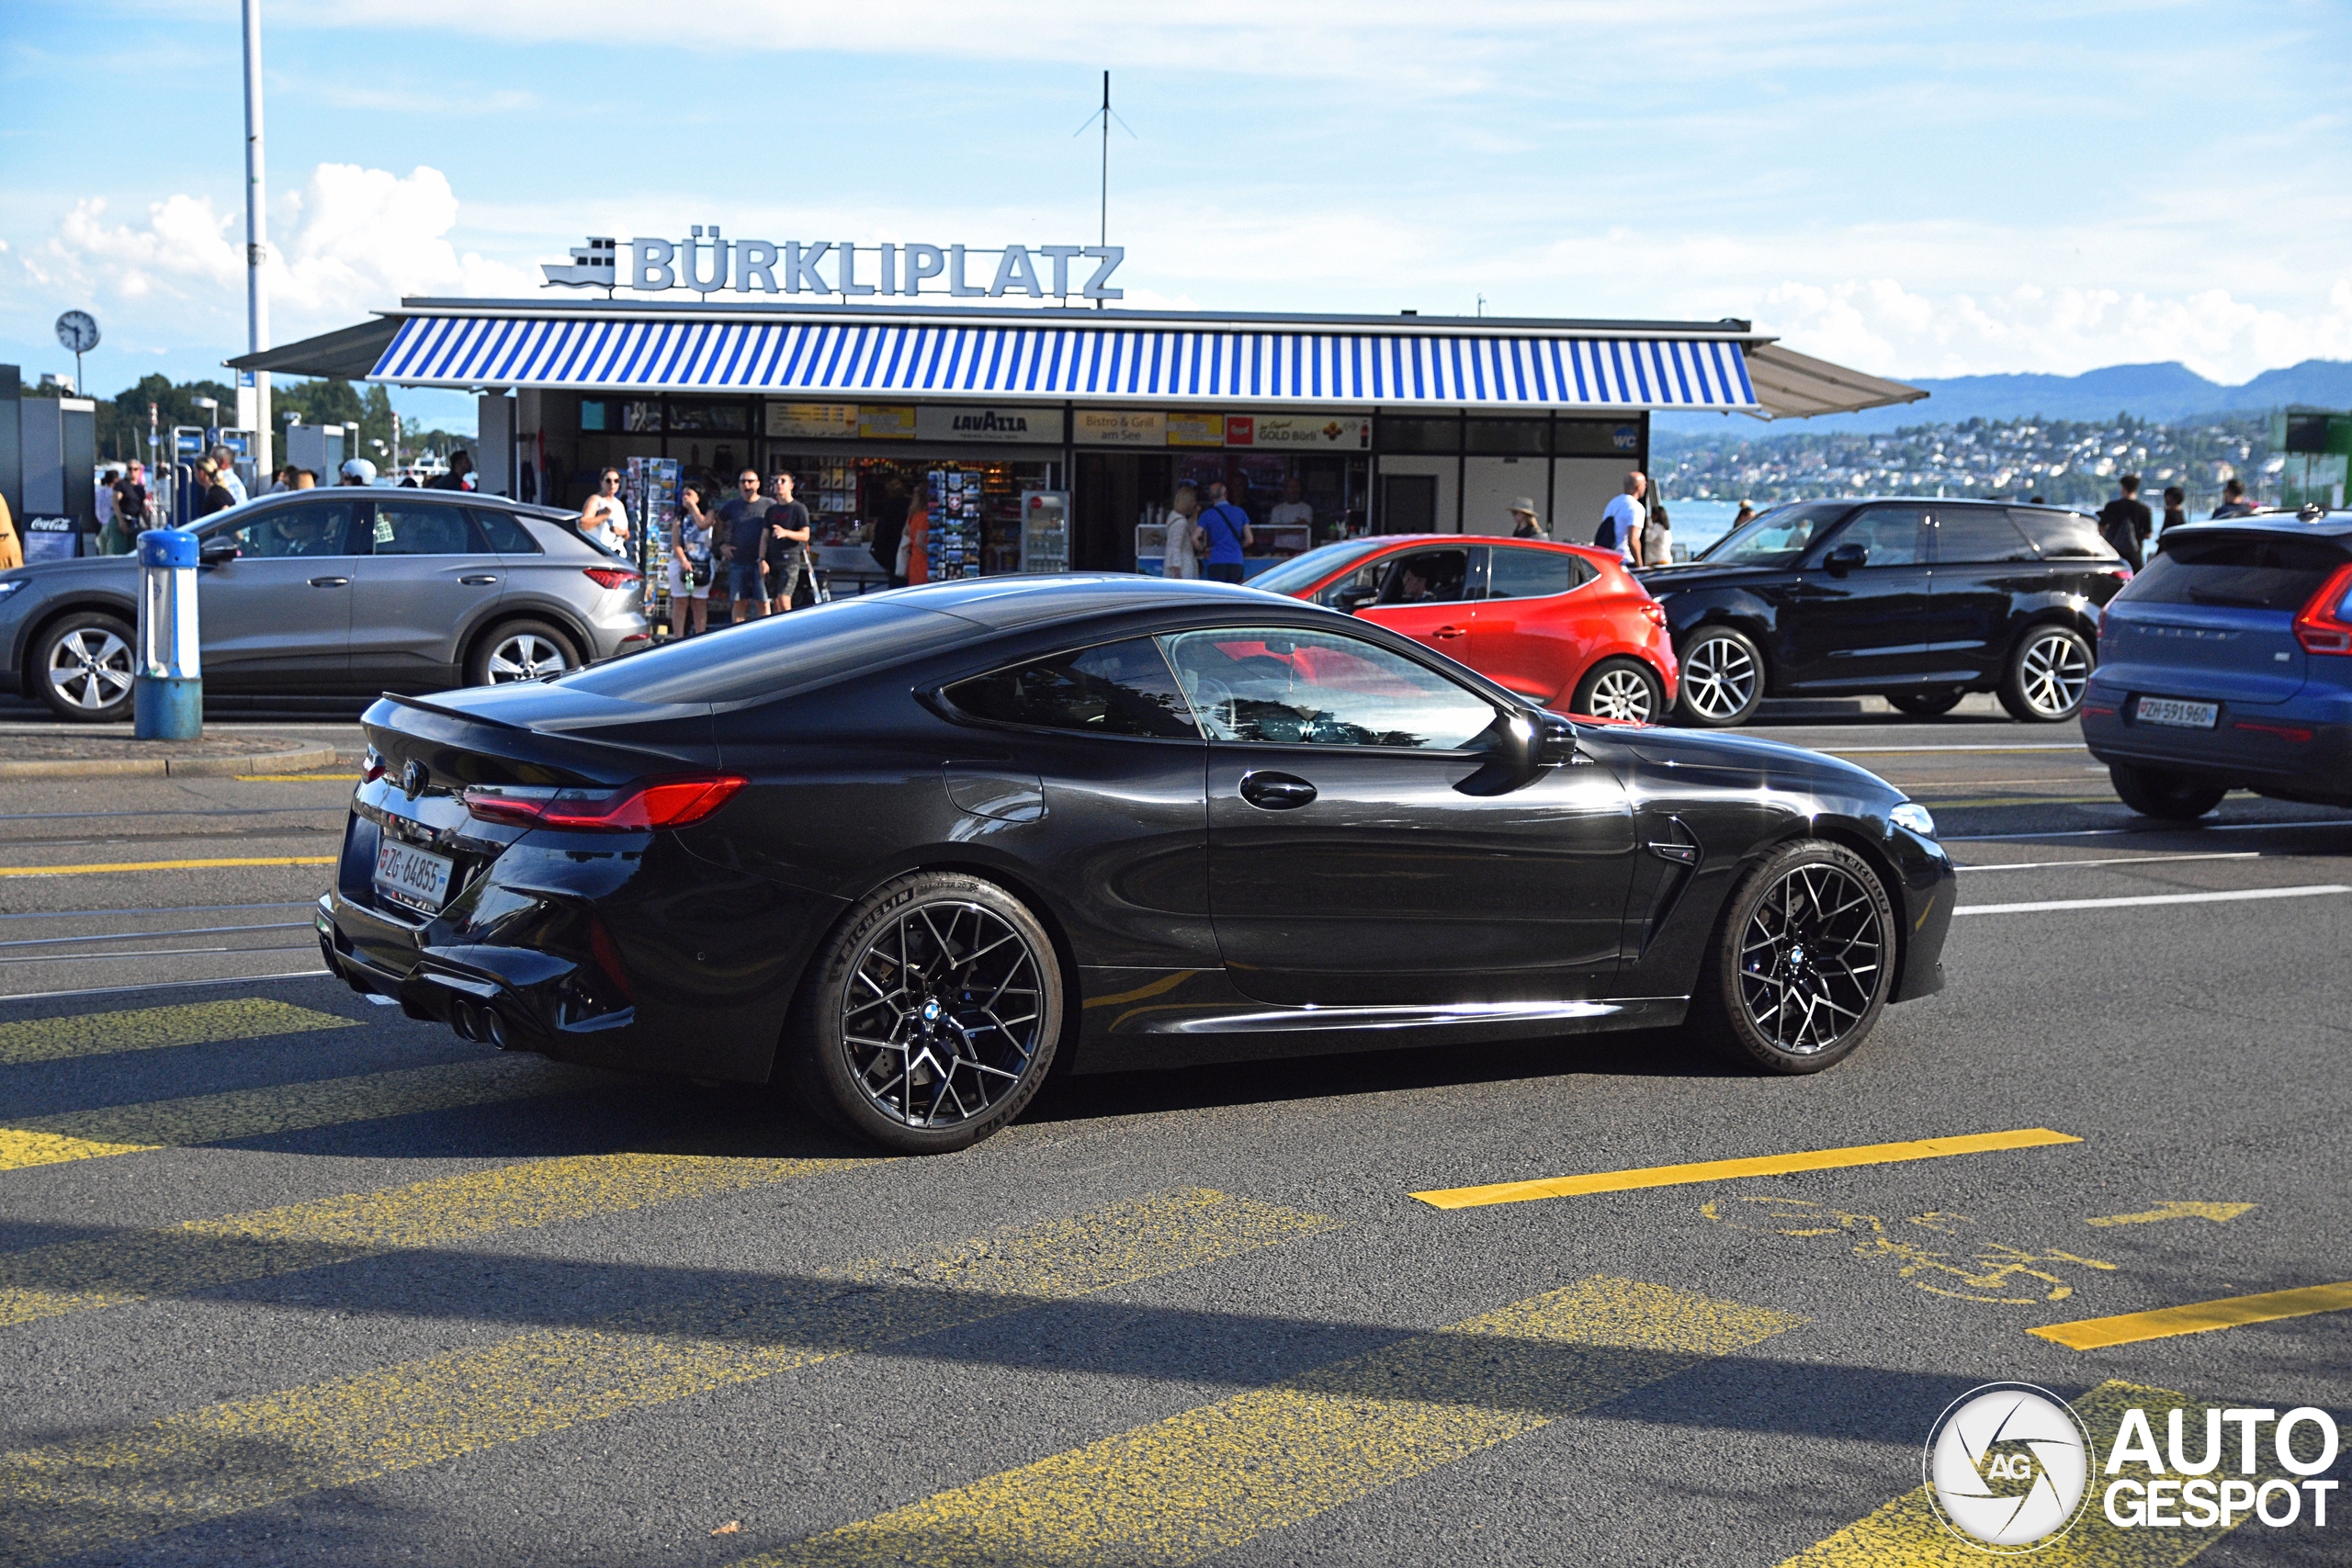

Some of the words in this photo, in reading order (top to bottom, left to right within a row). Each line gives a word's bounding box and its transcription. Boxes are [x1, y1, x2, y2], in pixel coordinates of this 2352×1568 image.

[632, 225, 1125, 299] BÜRKLIPLATZ
[953, 411, 1028, 432] LAVAZZA
[1086, 416, 1117, 427] Bistro
[1120, 417, 1128, 427] &
[1131, 417, 1155, 427] Grill
[1121, 431, 1141, 440] See
[1259, 430, 1290, 441] GOLD
[1612, 435, 1637, 448] WC
[2139, 626, 2227, 641] VOLVO
[1847, 857, 1889, 910] MICHELIN
[840, 890, 910, 961] MICHELIN
